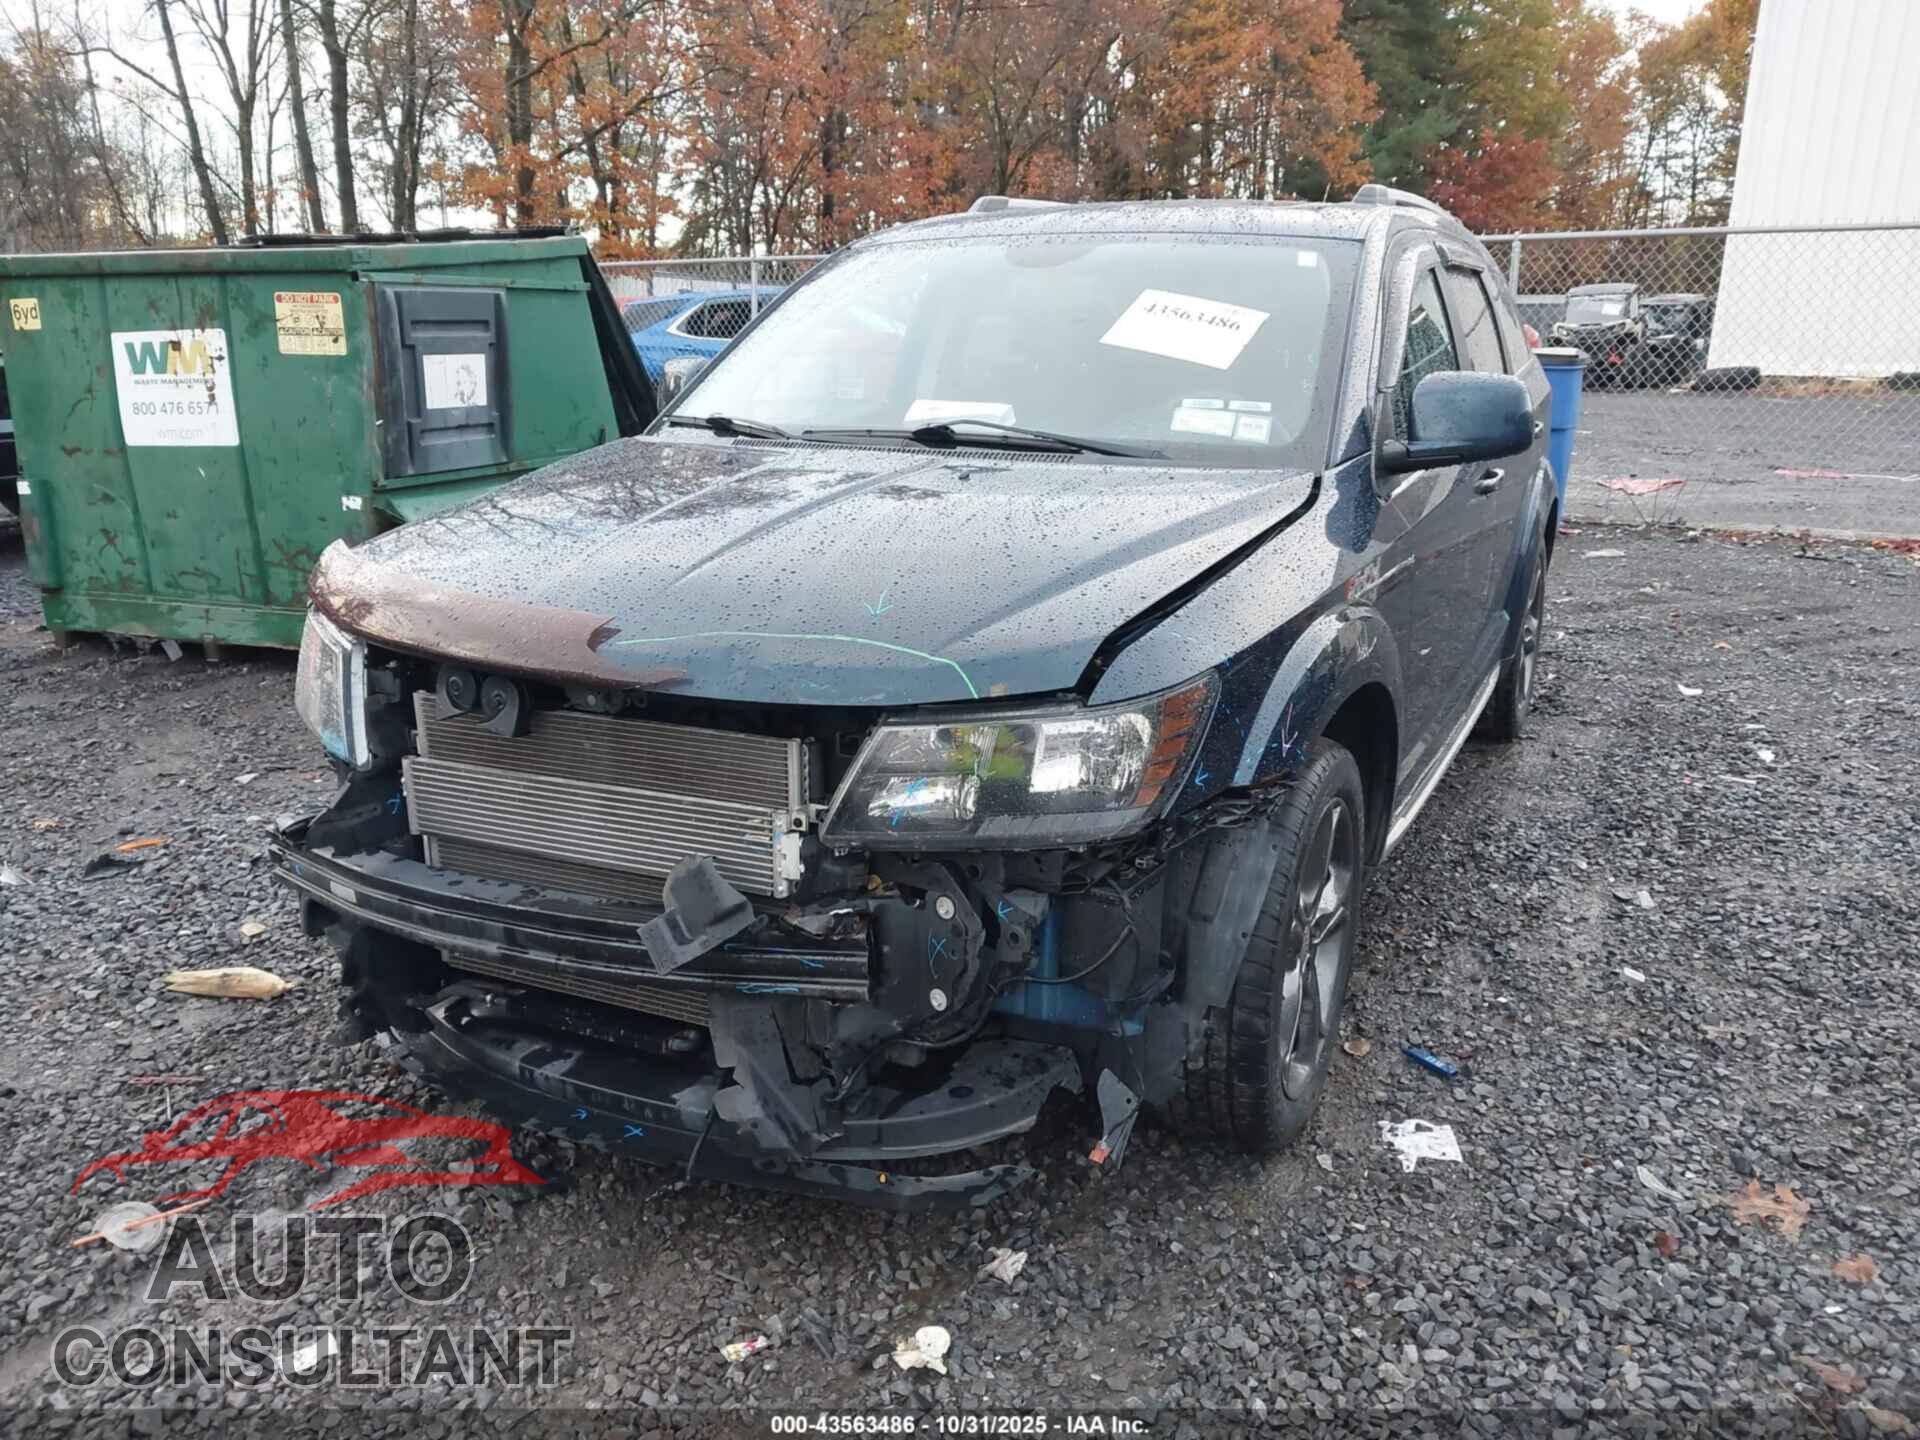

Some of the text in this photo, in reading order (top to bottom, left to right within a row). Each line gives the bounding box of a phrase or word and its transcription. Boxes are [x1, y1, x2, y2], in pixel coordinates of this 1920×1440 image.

[294, 294, 310, 304] NOT
[313, 294, 334, 304] PARK
[13, 303, 38, 325] 6yd
[1144, 303, 1241, 331] 43563486
[132, 401, 157, 415] 800
[160, 401, 184, 415] 476
